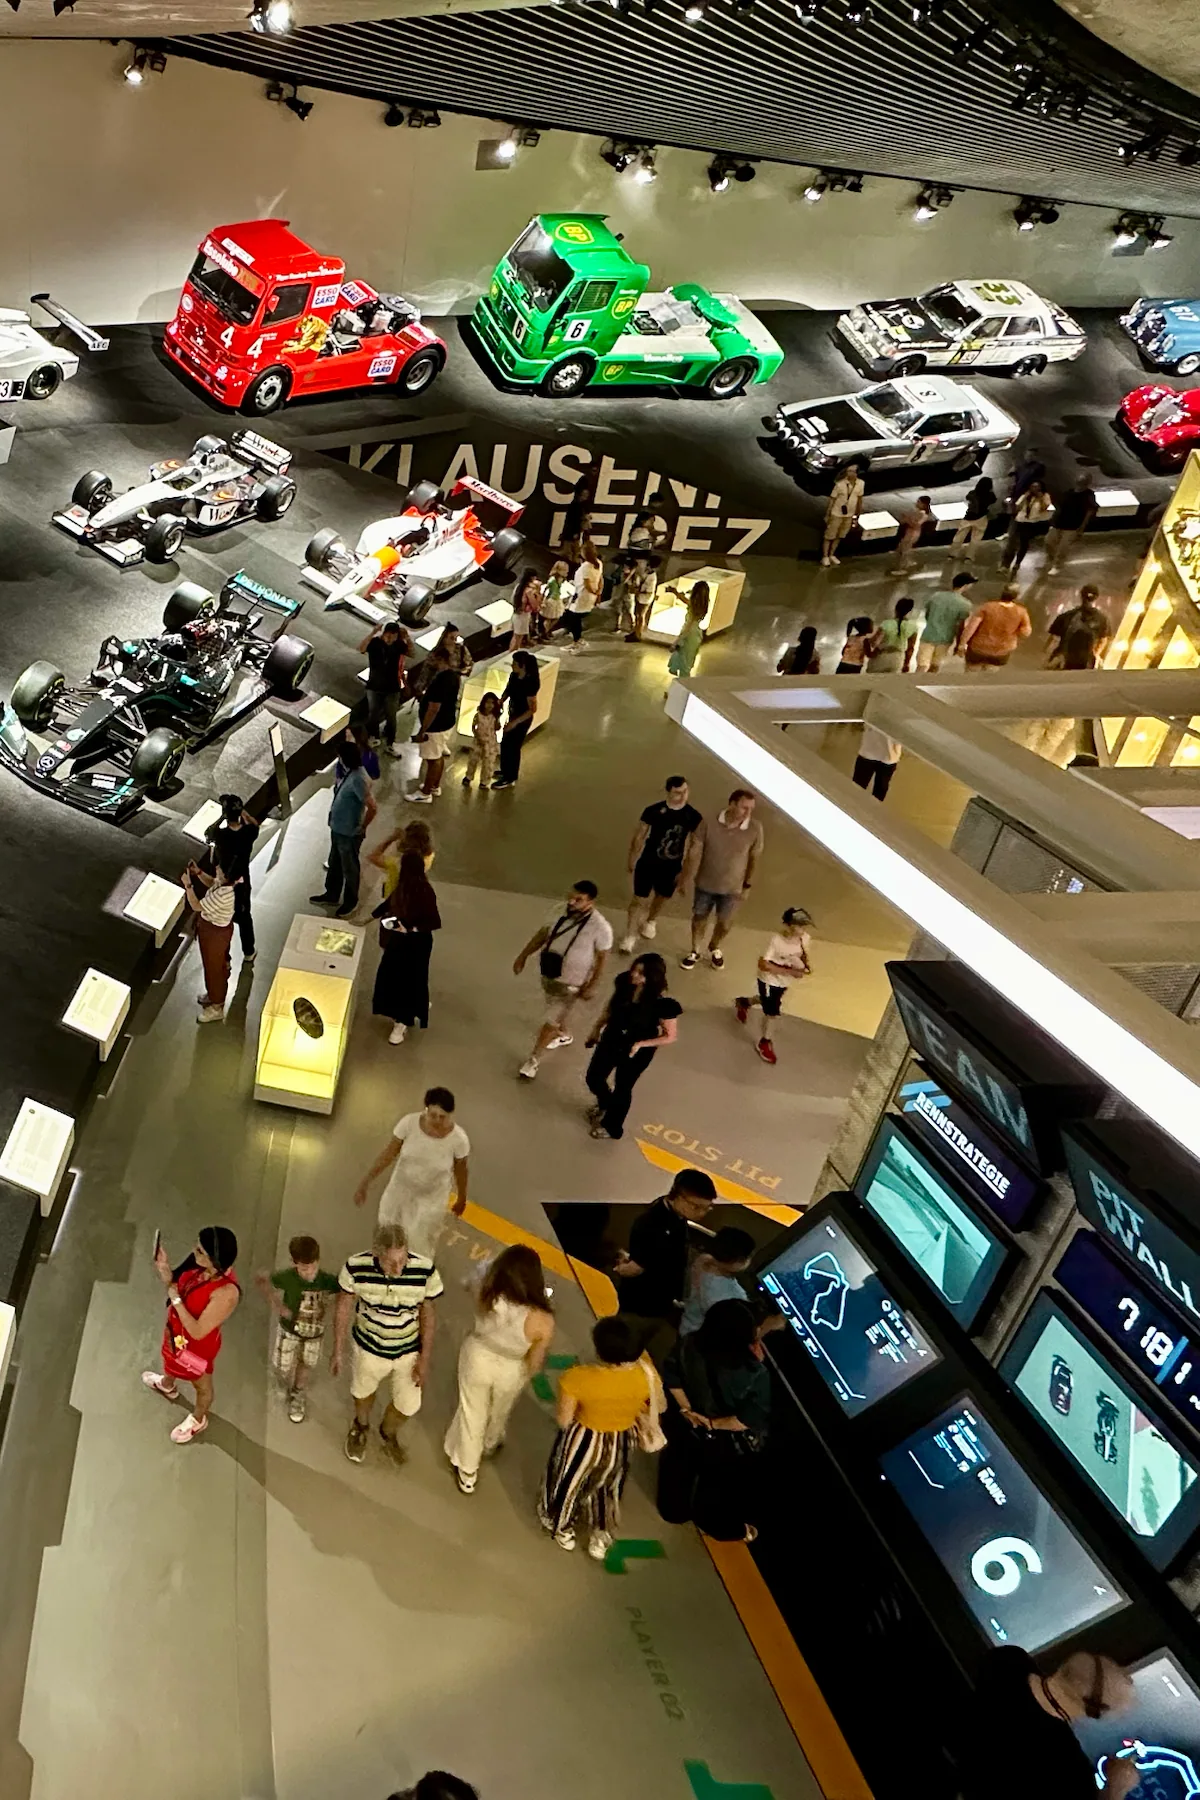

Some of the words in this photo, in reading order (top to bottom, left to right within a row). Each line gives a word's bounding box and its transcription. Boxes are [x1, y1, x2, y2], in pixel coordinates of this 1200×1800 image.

[563, 226, 588, 241] BP
[315, 296, 335, 305] CARD
[317, 287, 338, 297] ESSO
[615, 301, 633, 313] BP
[220, 326, 235, 348] 4
[570, 322, 585, 342] 6
[247, 337, 262, 358] 4
[370, 365, 392, 374] CARD
[605, 364, 624, 375] BP
[471, 480, 514, 508] Marlboro
[241, 575, 295, 606] PETRONAS
[641, 1122, 723, 1162] STOP
[916, 1091, 1011, 1195] RENNSTRATEGIE
[725, 1155, 783, 1190] PIT
[1088, 1169, 1145, 1238] PIT
[1096, 1199, 1200, 1320] WALL
[971, 1535, 1043, 1597] 6
[625, 1606, 672, 1686] PLAYER
